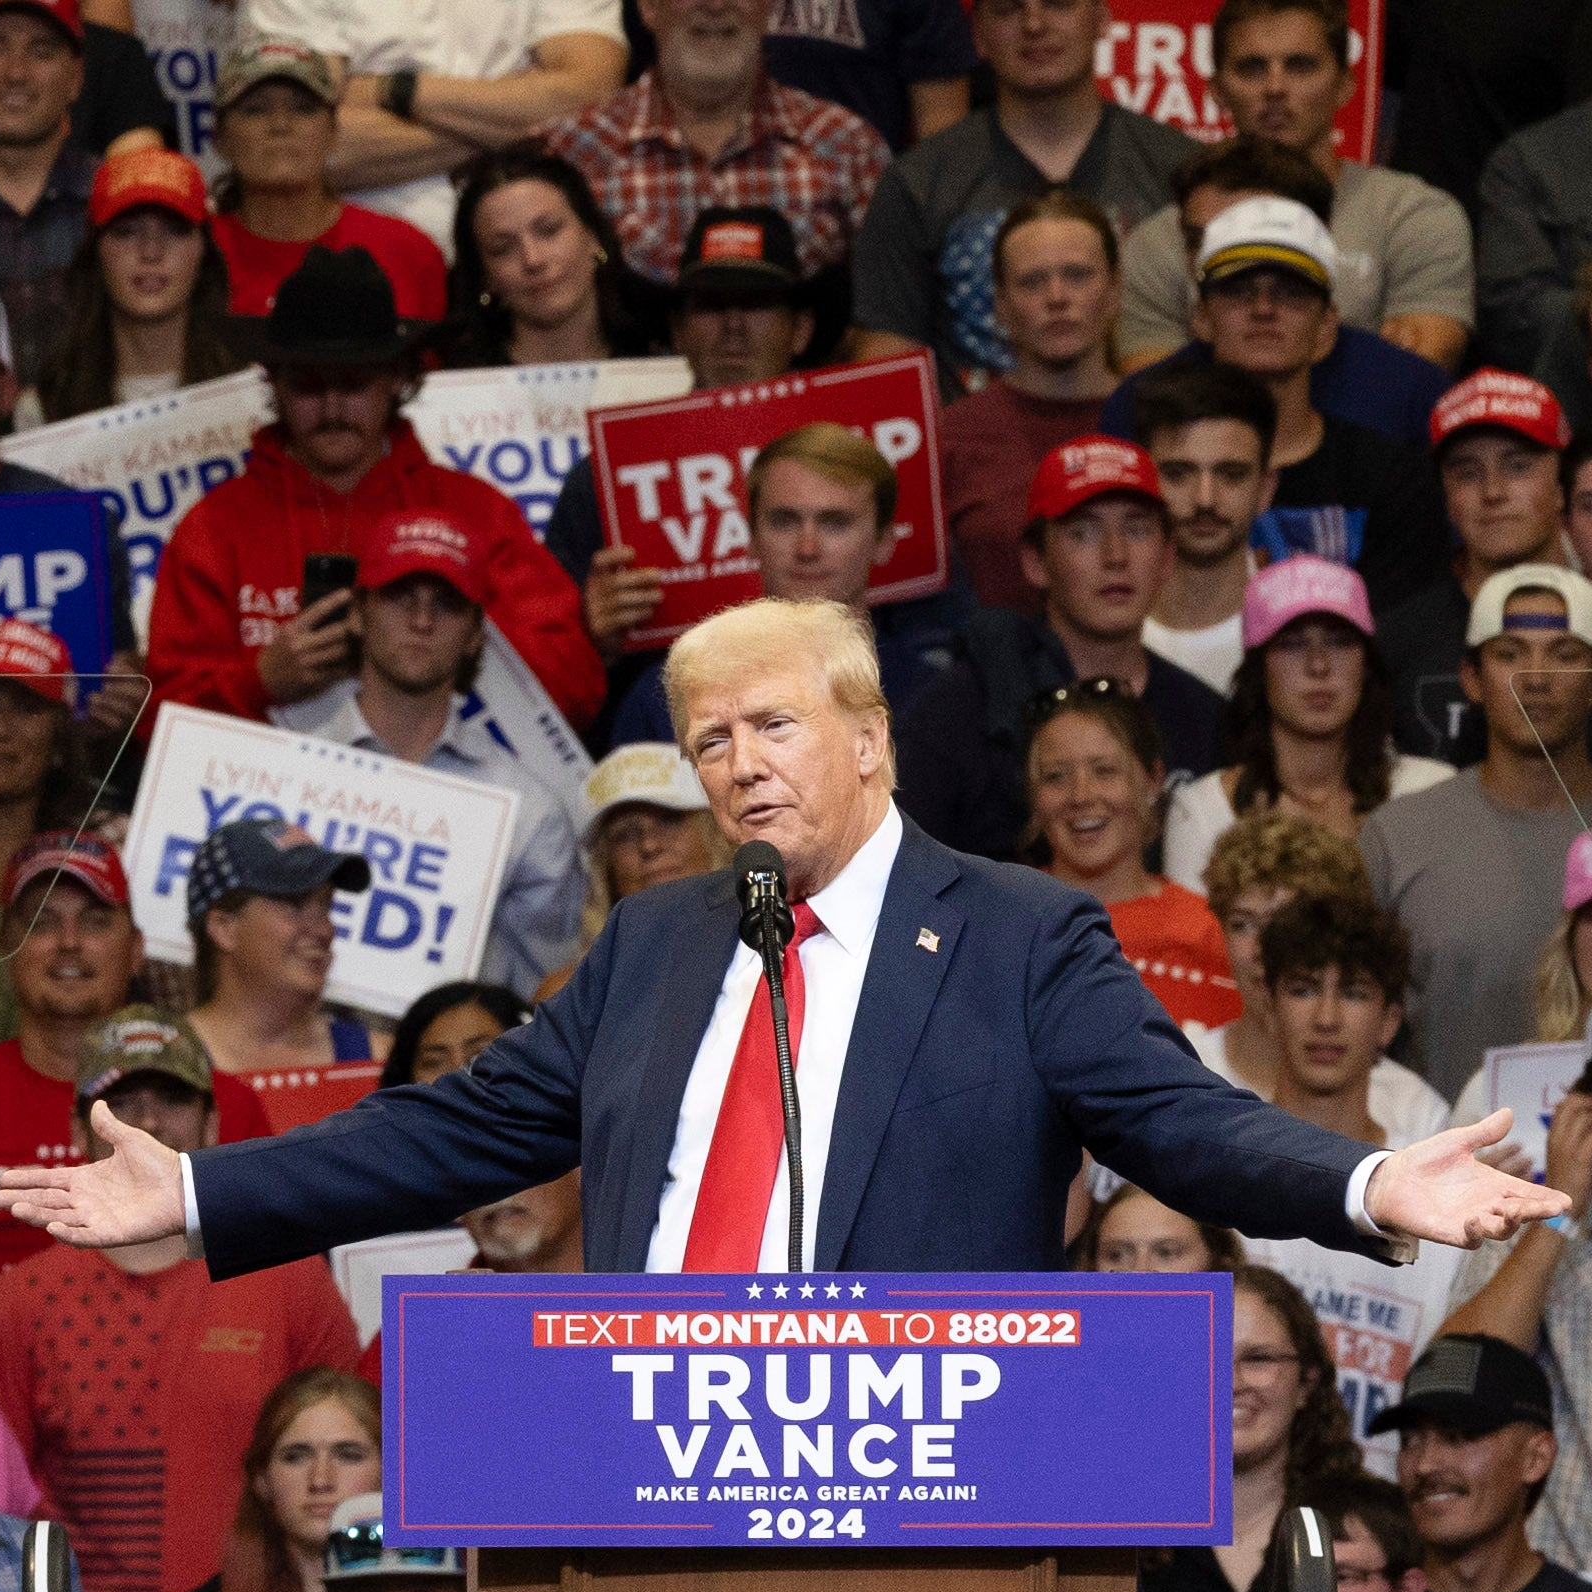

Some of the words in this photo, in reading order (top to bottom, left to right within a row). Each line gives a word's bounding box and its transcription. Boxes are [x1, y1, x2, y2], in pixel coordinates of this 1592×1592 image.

[444, 436, 581, 484] YOU
[616, 417, 923, 522] TRP
[302, 777, 449, 843] KAMALA
[538, 1314, 642, 1345] TEXT
[655, 1313, 869, 1345] MONTANA
[880, 1313, 935, 1344] TO
[948, 1312, 1076, 1345] 88022
[611, 1353, 1001, 1421] TRUMP
[655, 1423, 956, 1479] VANCE
[636, 1486, 699, 1502] MAKE
[706, 1485, 810, 1502] AMERICA
[816, 1485, 891, 1502] GREAT
[897, 1485, 978, 1502] AGAIN!
[747, 1508, 867, 1540] 2024
